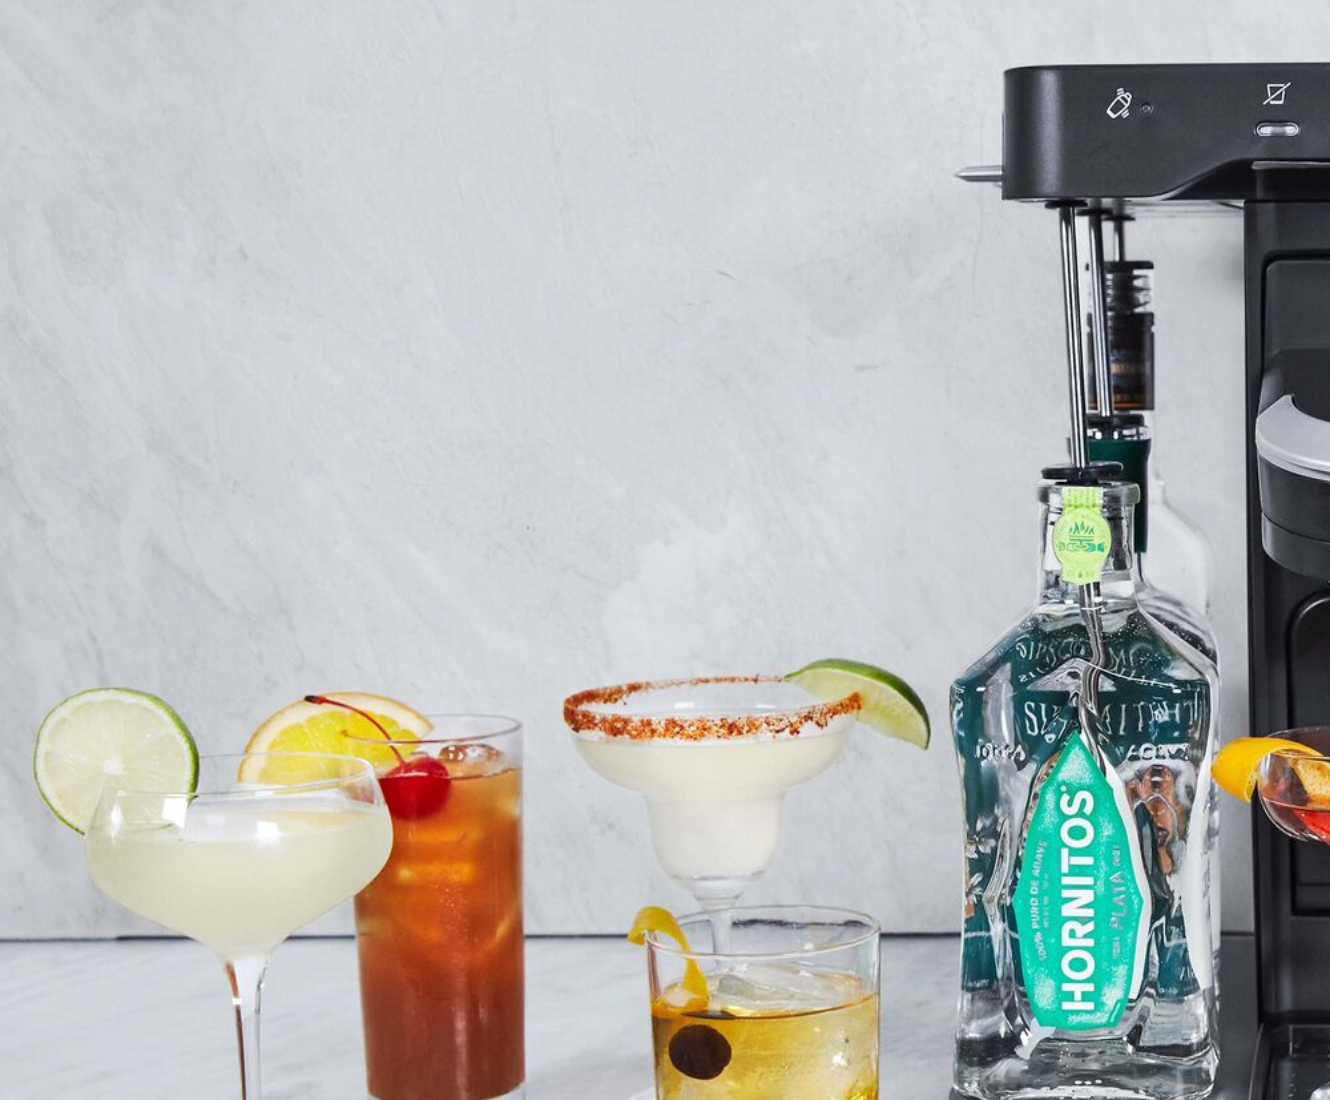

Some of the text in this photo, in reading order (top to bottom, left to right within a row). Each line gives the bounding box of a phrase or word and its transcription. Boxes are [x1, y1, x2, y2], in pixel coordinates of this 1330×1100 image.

[1029, 879, 1040, 895] DE
[1108, 870, 1128, 931] PLATA
[1029, 898, 1041, 930] PURO
